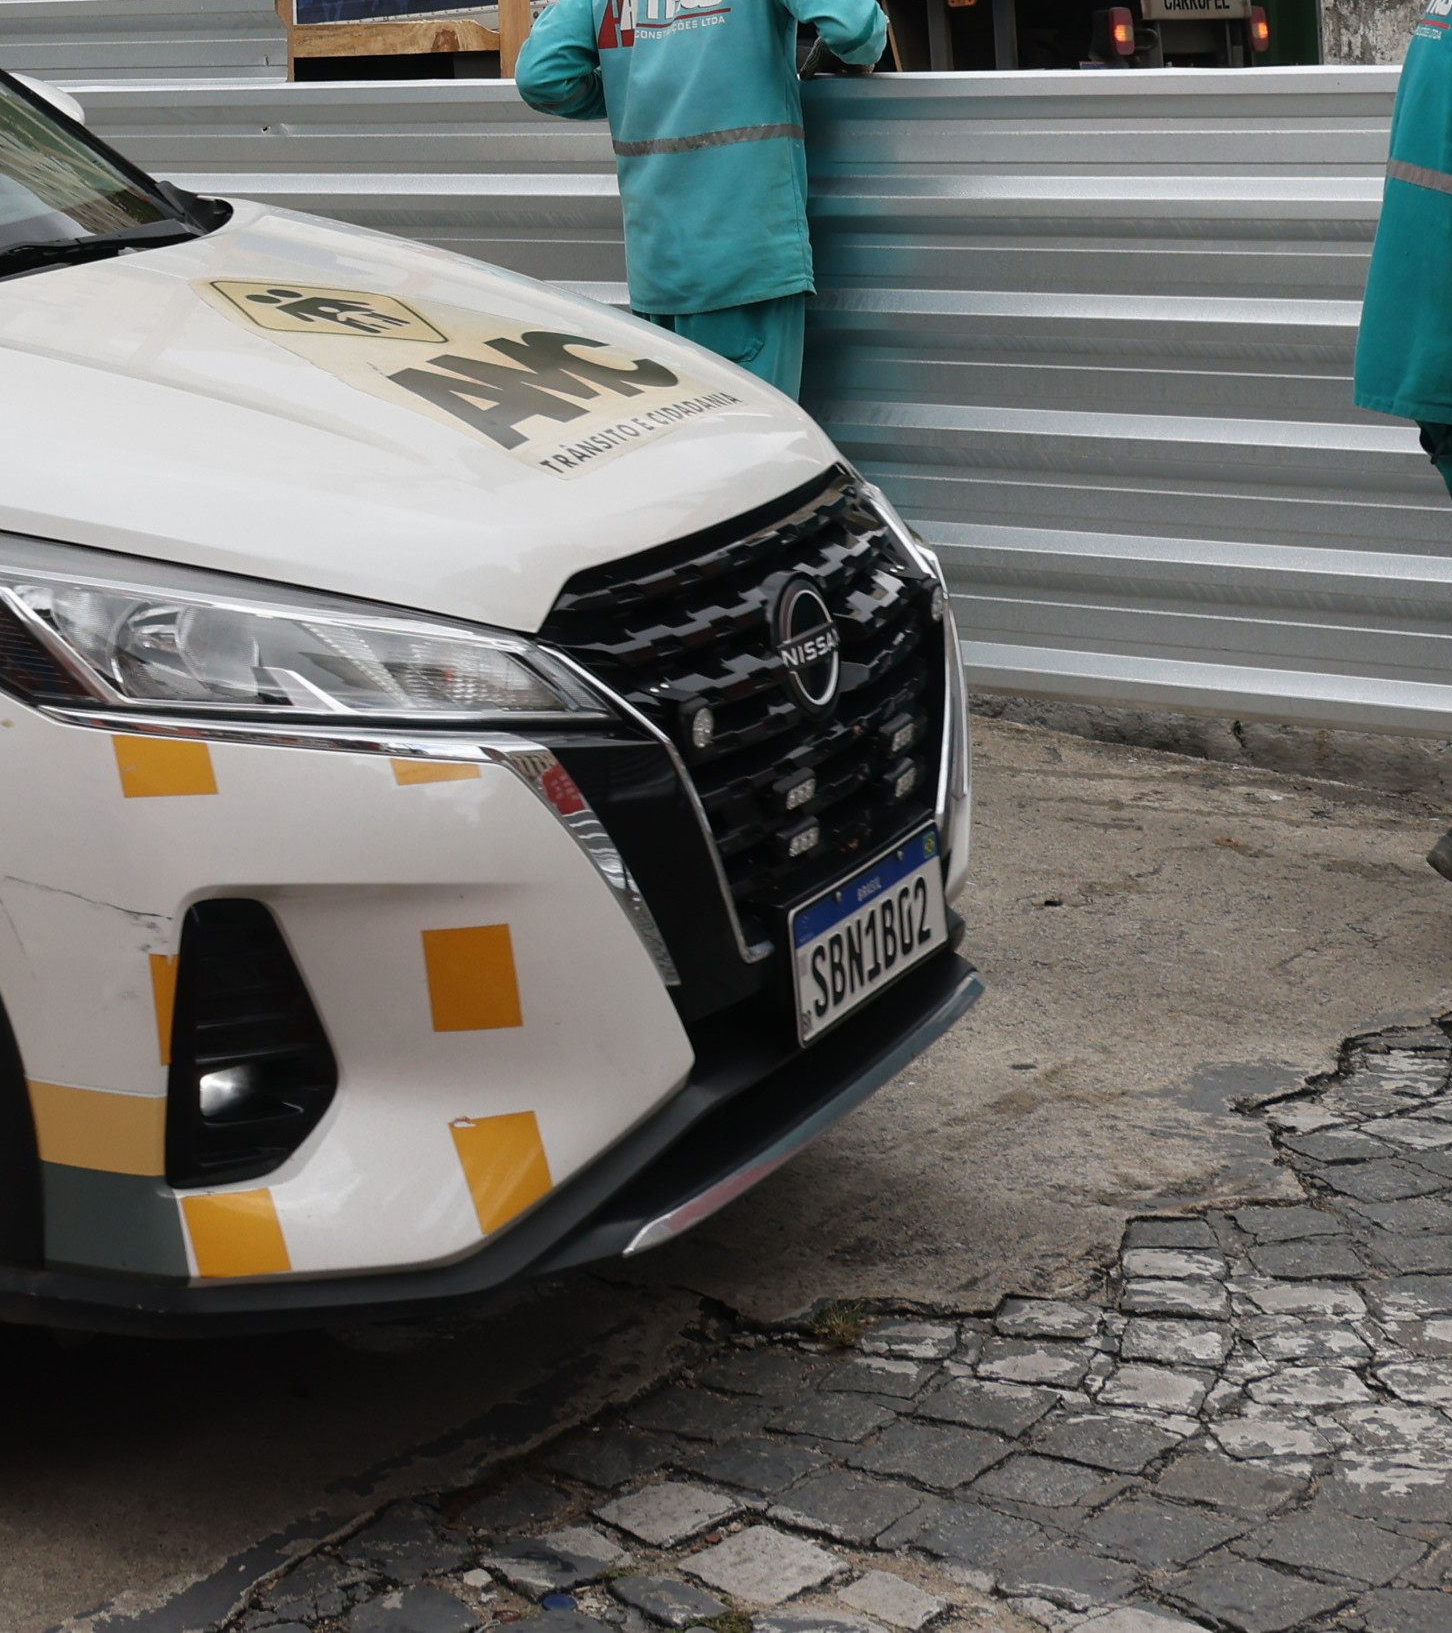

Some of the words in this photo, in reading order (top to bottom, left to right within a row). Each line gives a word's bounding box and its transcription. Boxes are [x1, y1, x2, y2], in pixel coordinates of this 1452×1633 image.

[701, 15, 725, 28] LTDA
[387, 330, 679, 451] AMC
[539, 423, 641, 475] TRÂNSITO
[646, 391, 744, 427] CIDADANIA
[780, 627, 841, 669] NISSAN
